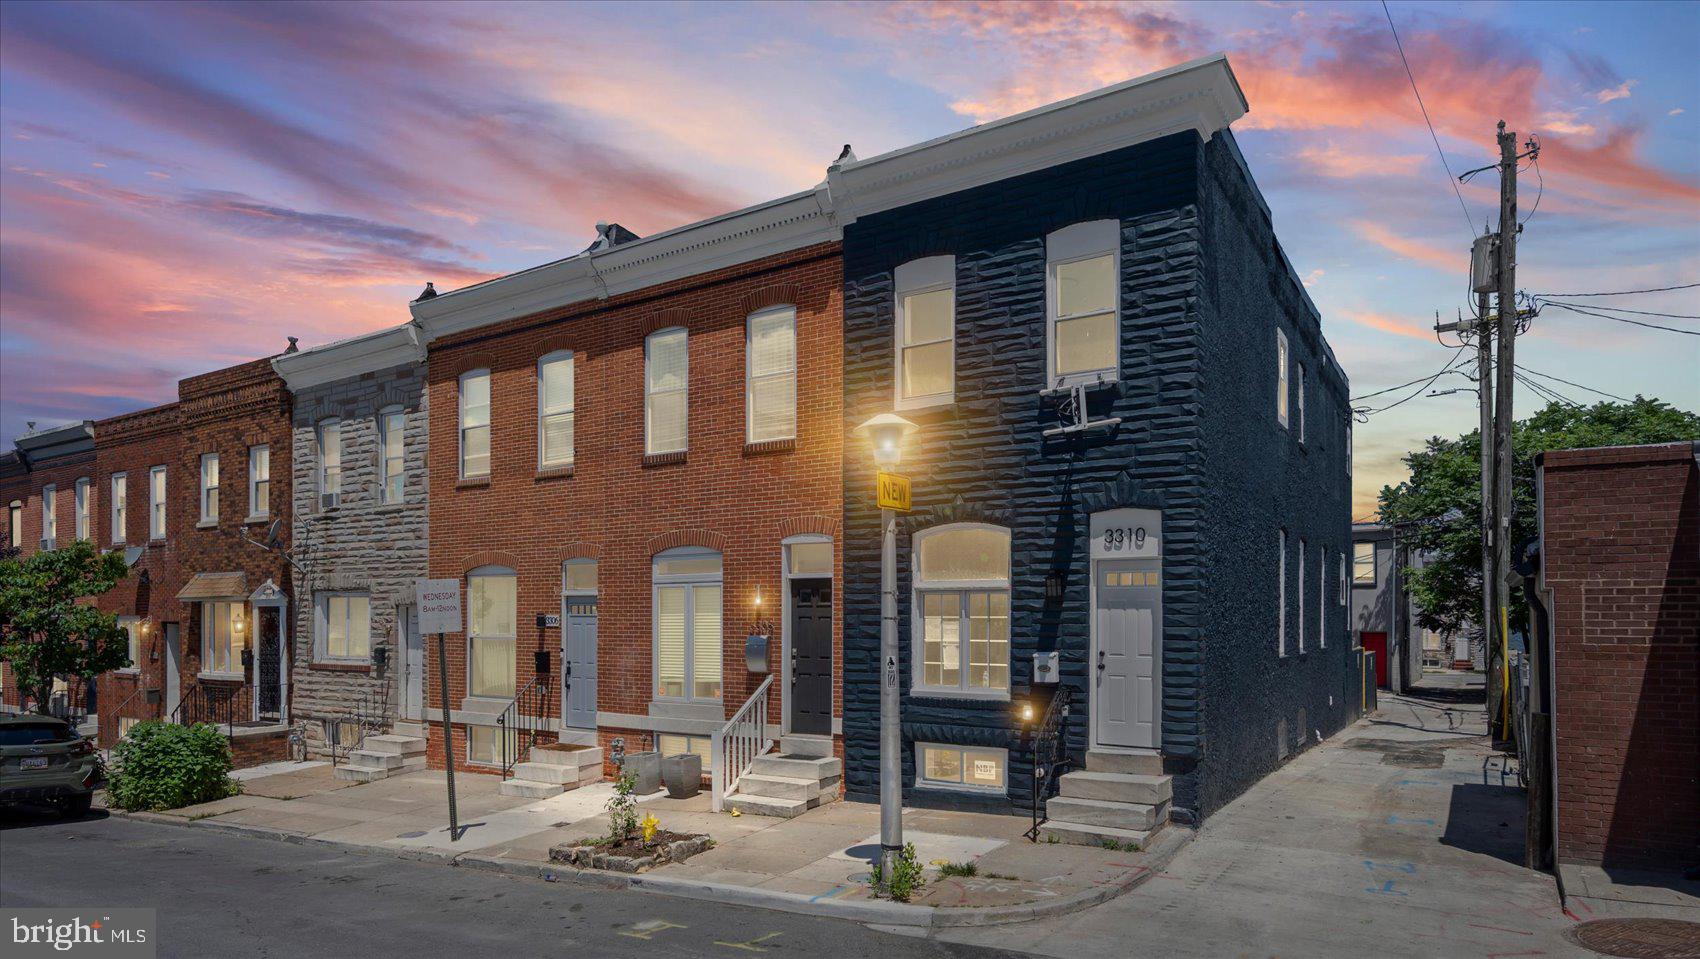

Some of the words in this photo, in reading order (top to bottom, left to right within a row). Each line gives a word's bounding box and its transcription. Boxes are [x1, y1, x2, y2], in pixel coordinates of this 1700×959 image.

[882, 480, 908, 503] NEW
[1104, 527, 1146, 543] 3310
[423, 592, 456, 601] WEDNESDAY
